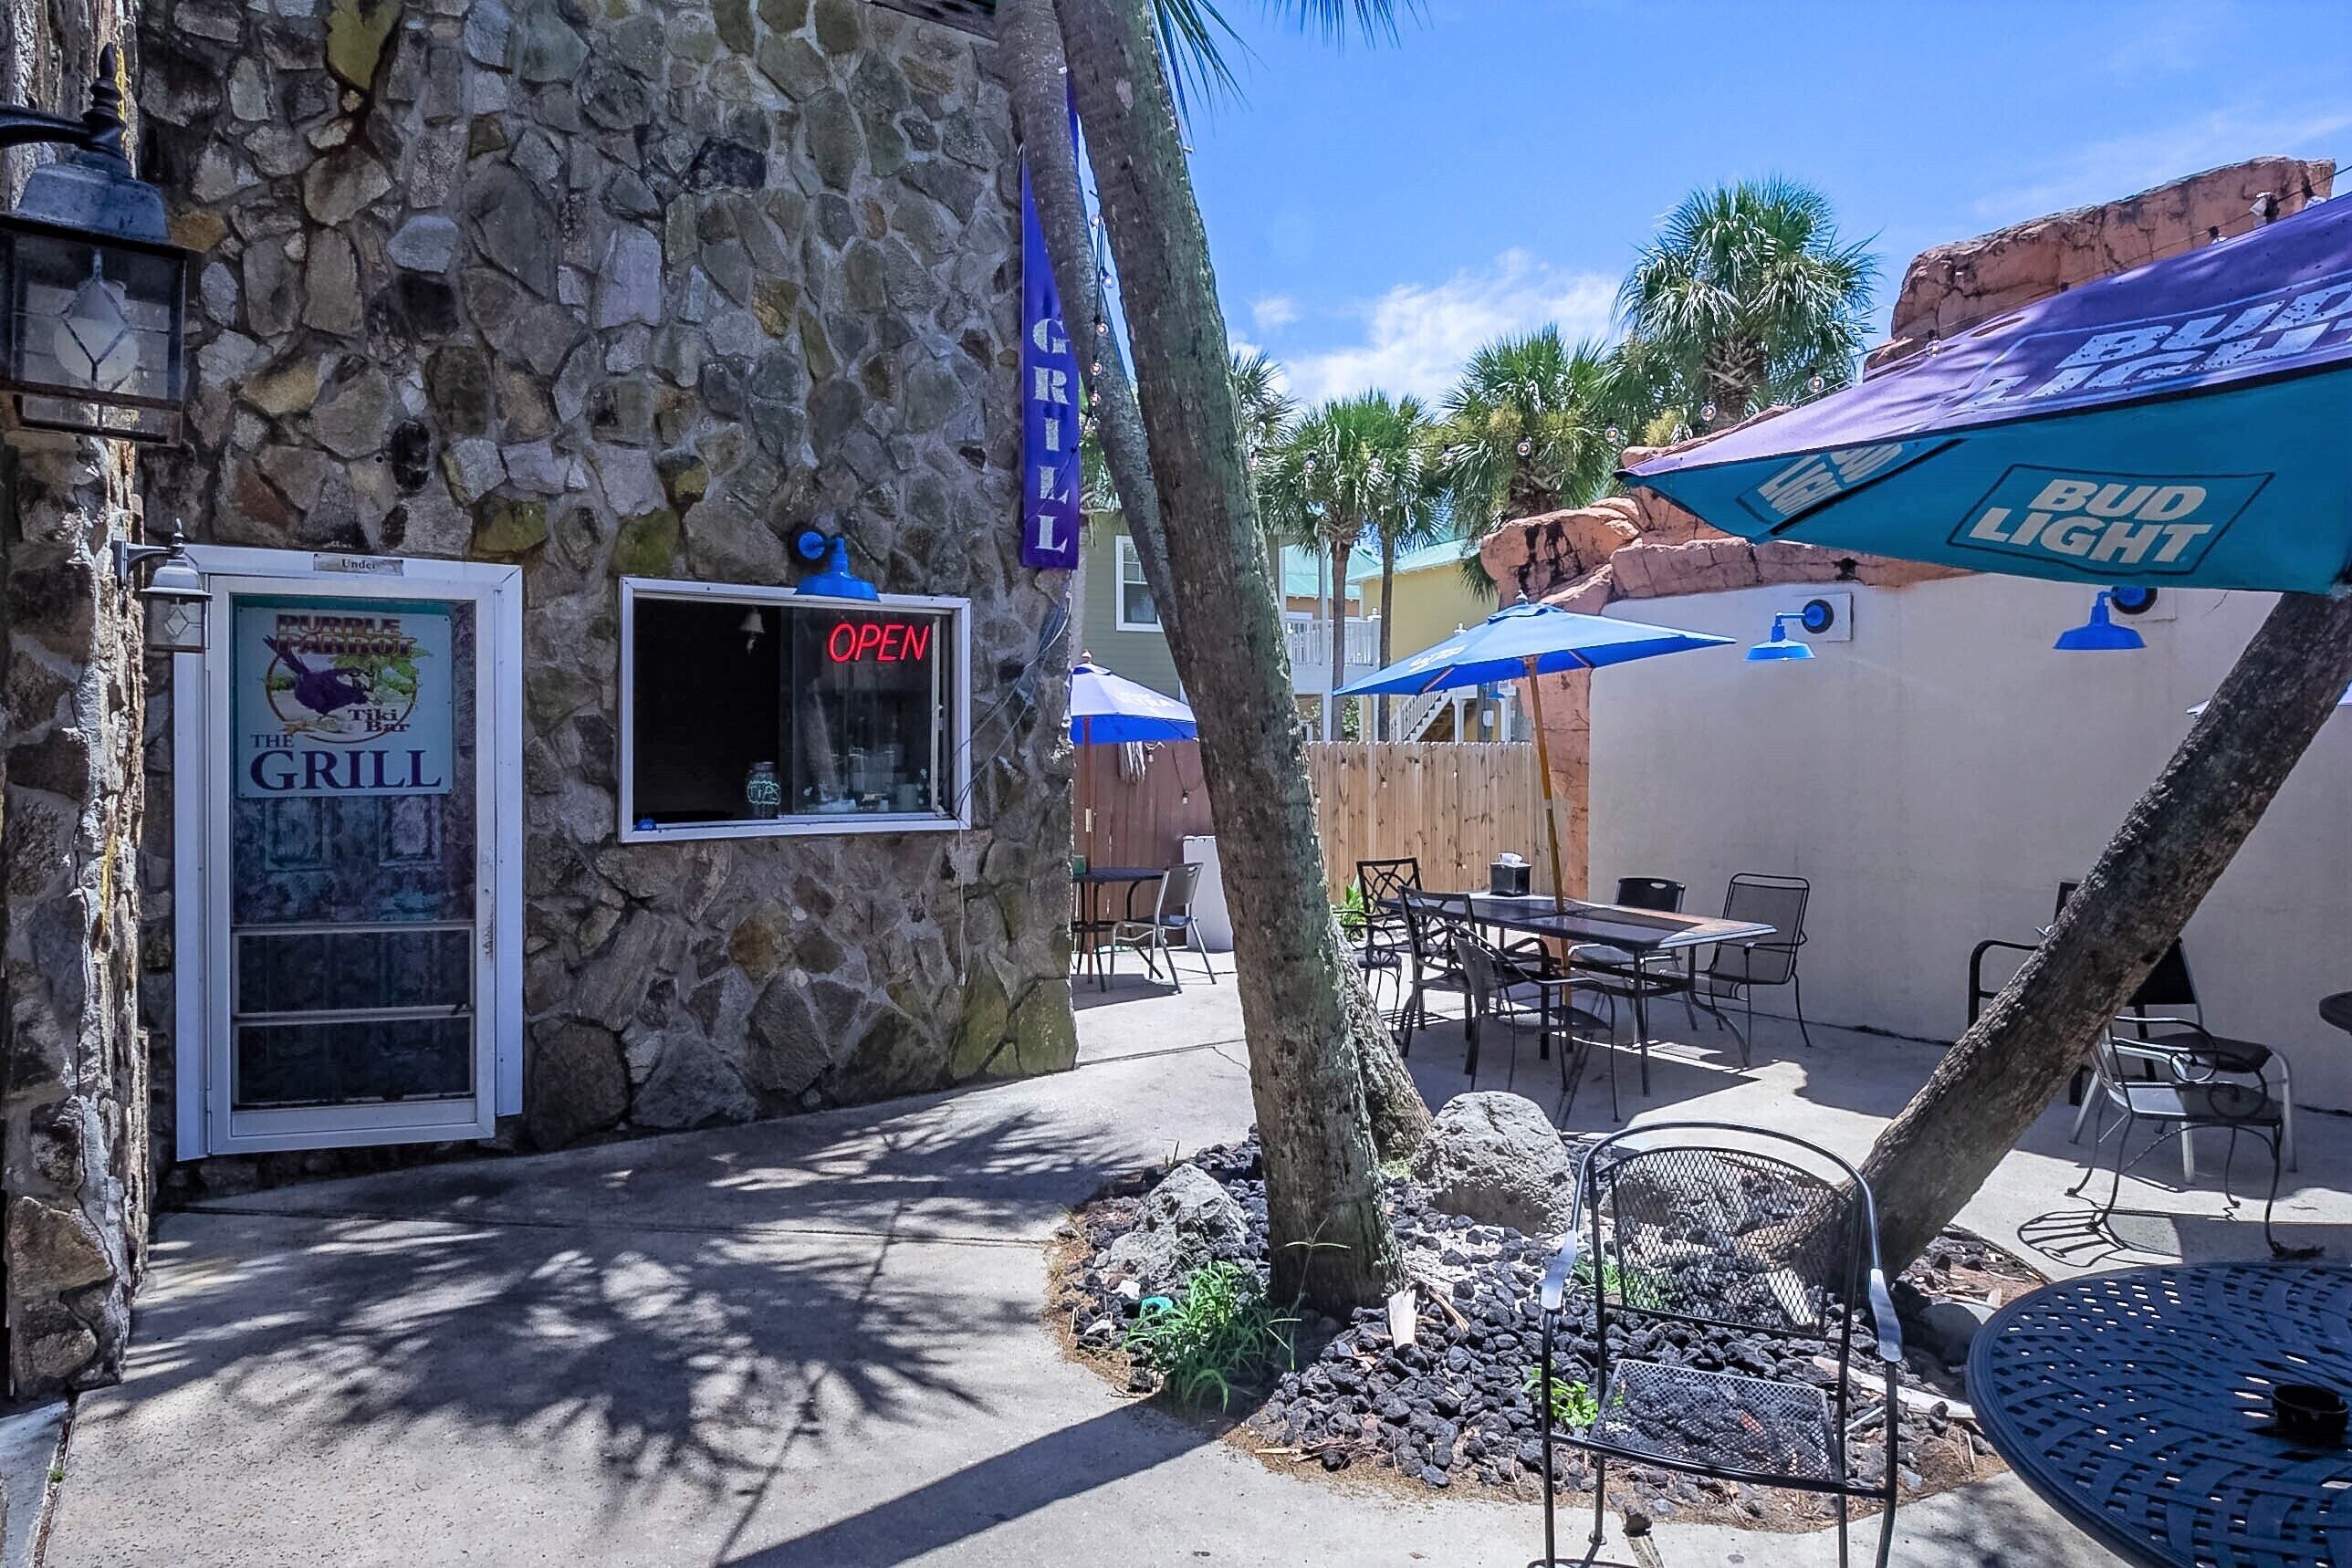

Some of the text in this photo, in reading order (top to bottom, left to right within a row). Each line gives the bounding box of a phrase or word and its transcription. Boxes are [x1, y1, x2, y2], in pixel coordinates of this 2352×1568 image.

[2055, 281, 2352, 369] BUD
[1956, 318, 2352, 408] LIGH
[1032, 319, 1071, 554] GRILL
[2028, 479, 2207, 521] BUD
[1969, 507, 2213, 564] LIGHT
[828, 623, 929, 662] OPEN
[348, 707, 399, 721] Tiki
[366, 720, 410, 732] Bar
[250, 734, 294, 748] THE
[250, 749, 442, 791] GRILL
